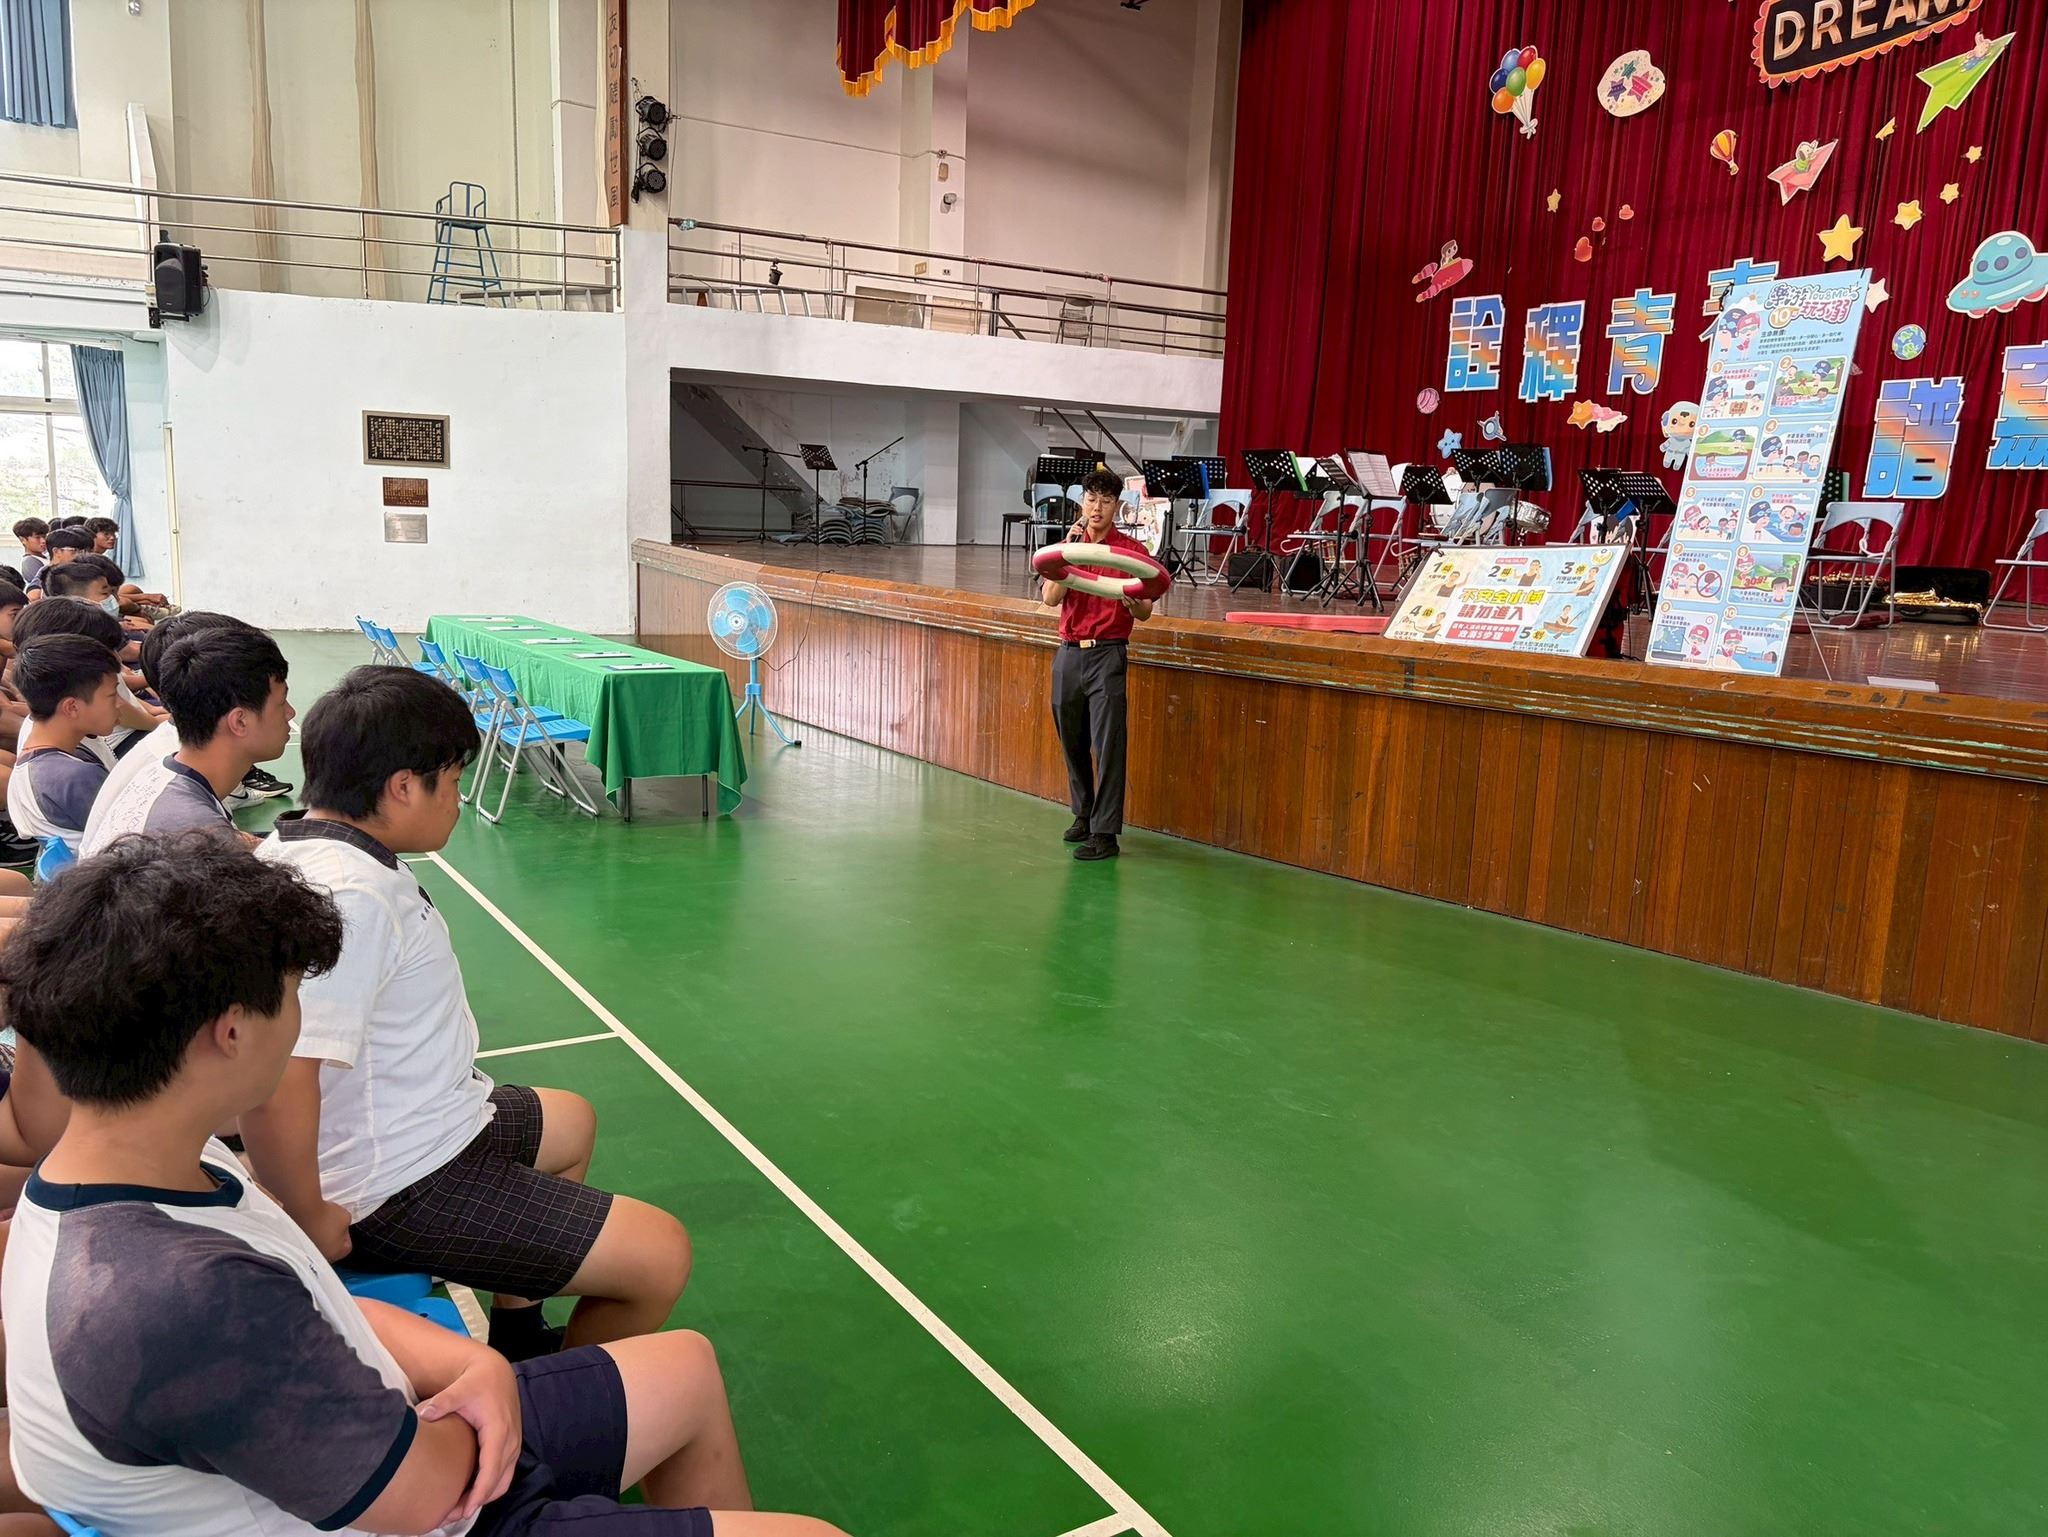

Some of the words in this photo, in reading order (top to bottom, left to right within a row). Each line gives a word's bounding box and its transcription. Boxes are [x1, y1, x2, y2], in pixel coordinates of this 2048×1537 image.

[1460, 588, 1545, 605] 不安全水域
[1457, 604, 1523, 621] 請勿進入
[1519, 627, 1533, 639] 5
